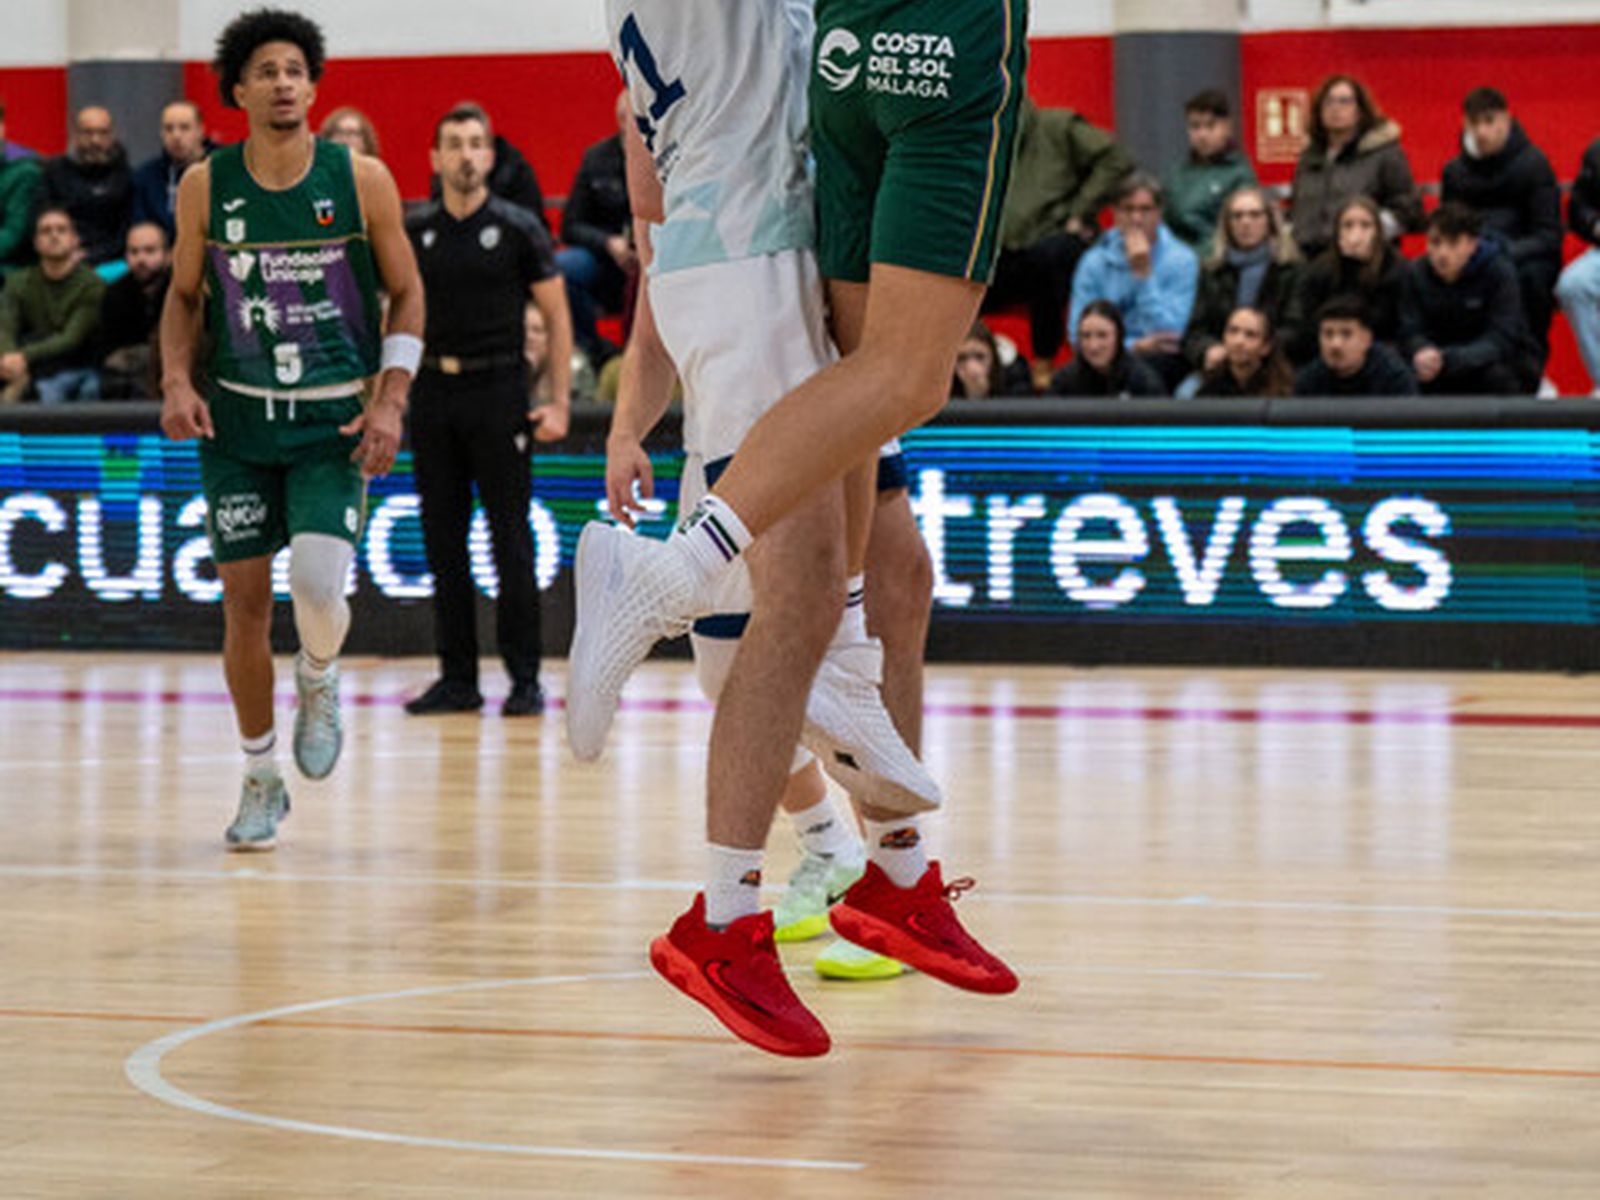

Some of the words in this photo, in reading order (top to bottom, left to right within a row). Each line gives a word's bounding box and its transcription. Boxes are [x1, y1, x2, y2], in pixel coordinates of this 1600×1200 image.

[871, 32, 955, 58] COSTA
[618, 12, 686, 145] 1
[868, 55, 903, 75] DEL
[907, 57, 952, 79] SOL
[273, 343, 302, 385] 5
